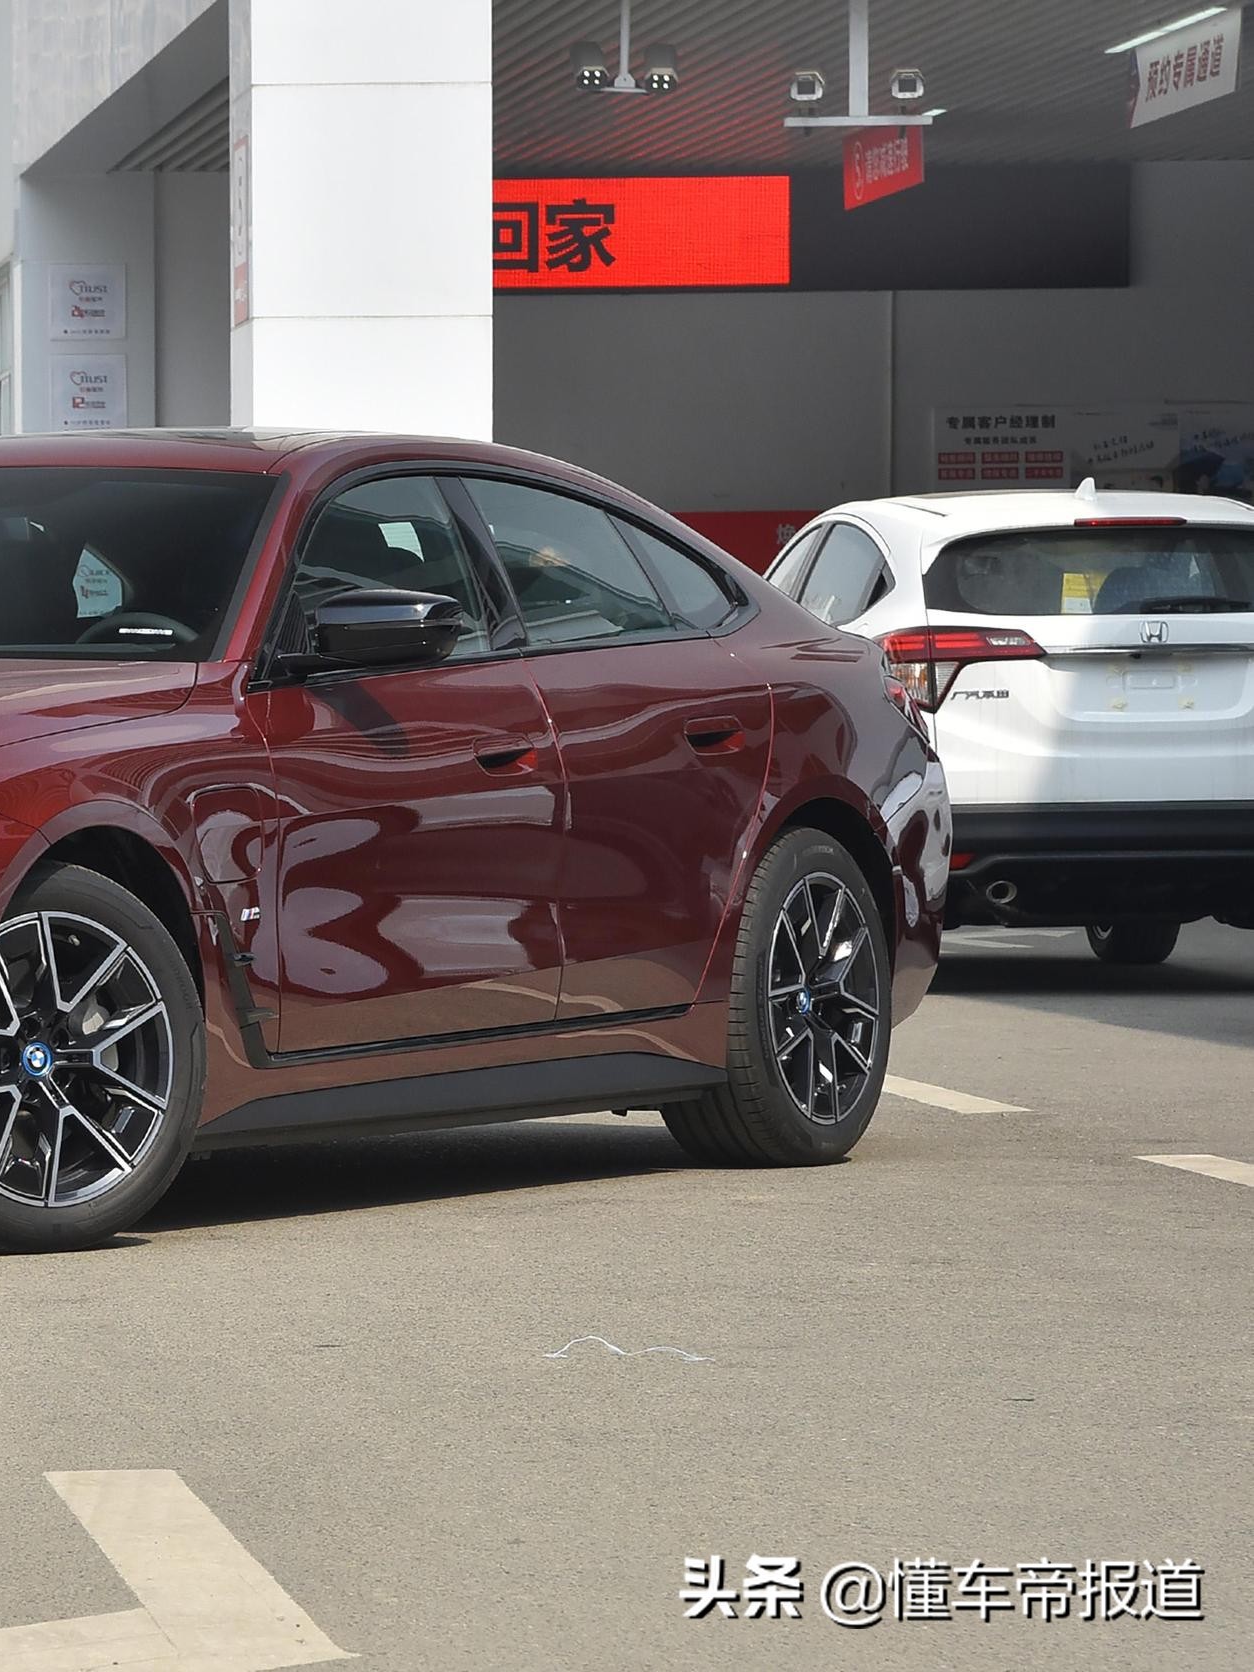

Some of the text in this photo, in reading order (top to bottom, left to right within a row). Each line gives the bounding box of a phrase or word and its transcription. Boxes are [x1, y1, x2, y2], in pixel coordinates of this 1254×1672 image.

[1145, 33, 1224, 102] 预约专属通道
[492, 198, 616, 272] 回家
[947, 415, 1056, 429] 专属客户经理制
